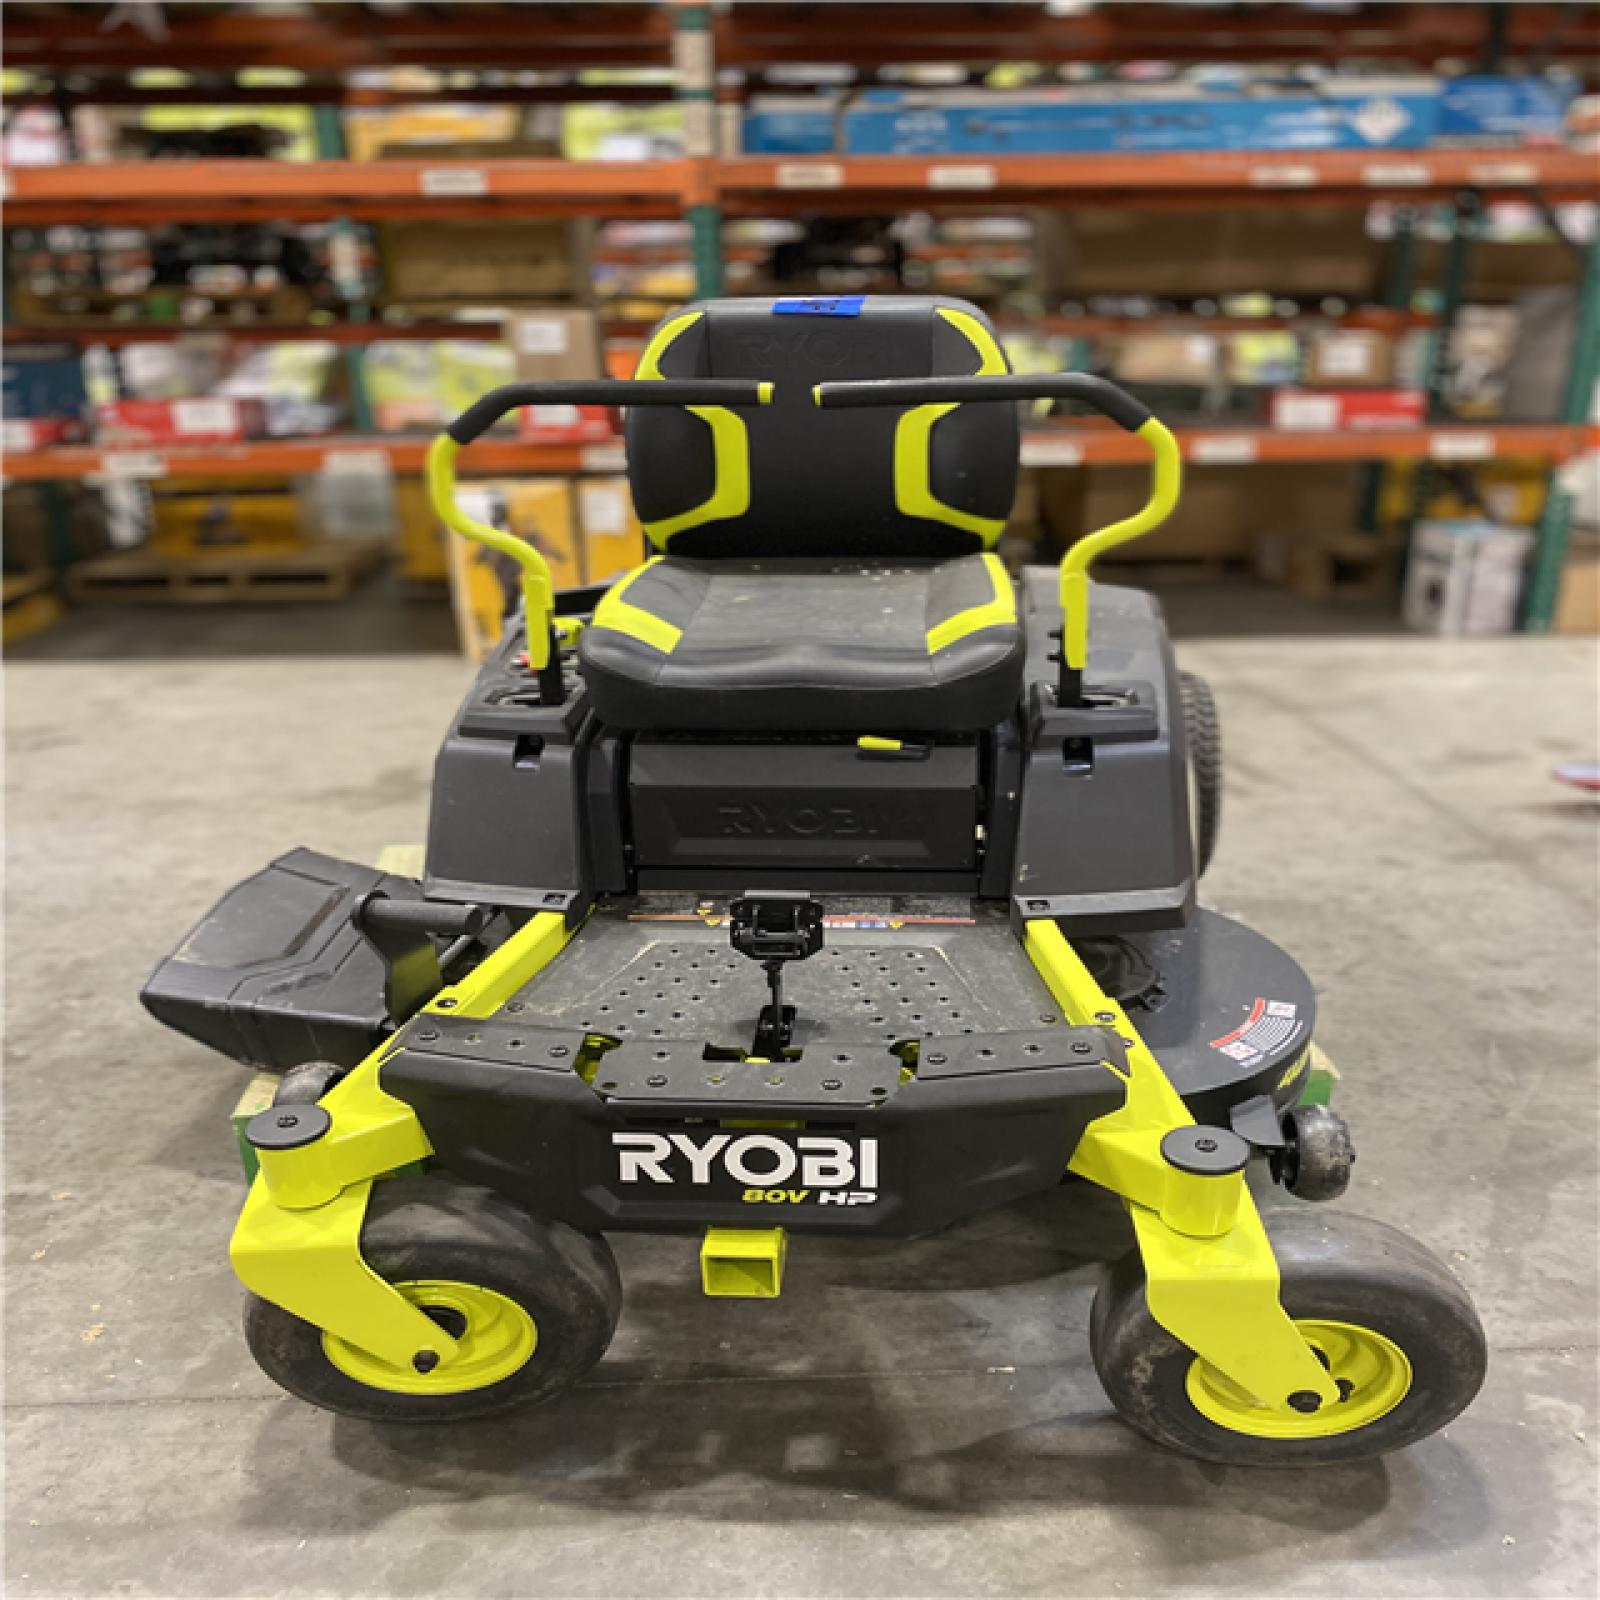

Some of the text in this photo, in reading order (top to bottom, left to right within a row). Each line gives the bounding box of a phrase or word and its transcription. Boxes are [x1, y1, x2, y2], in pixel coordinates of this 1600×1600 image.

[718, 806, 880, 834] RYOBI
[612, 1132, 879, 1188] RYOBI
[742, 1189, 878, 1206] 80V HP
